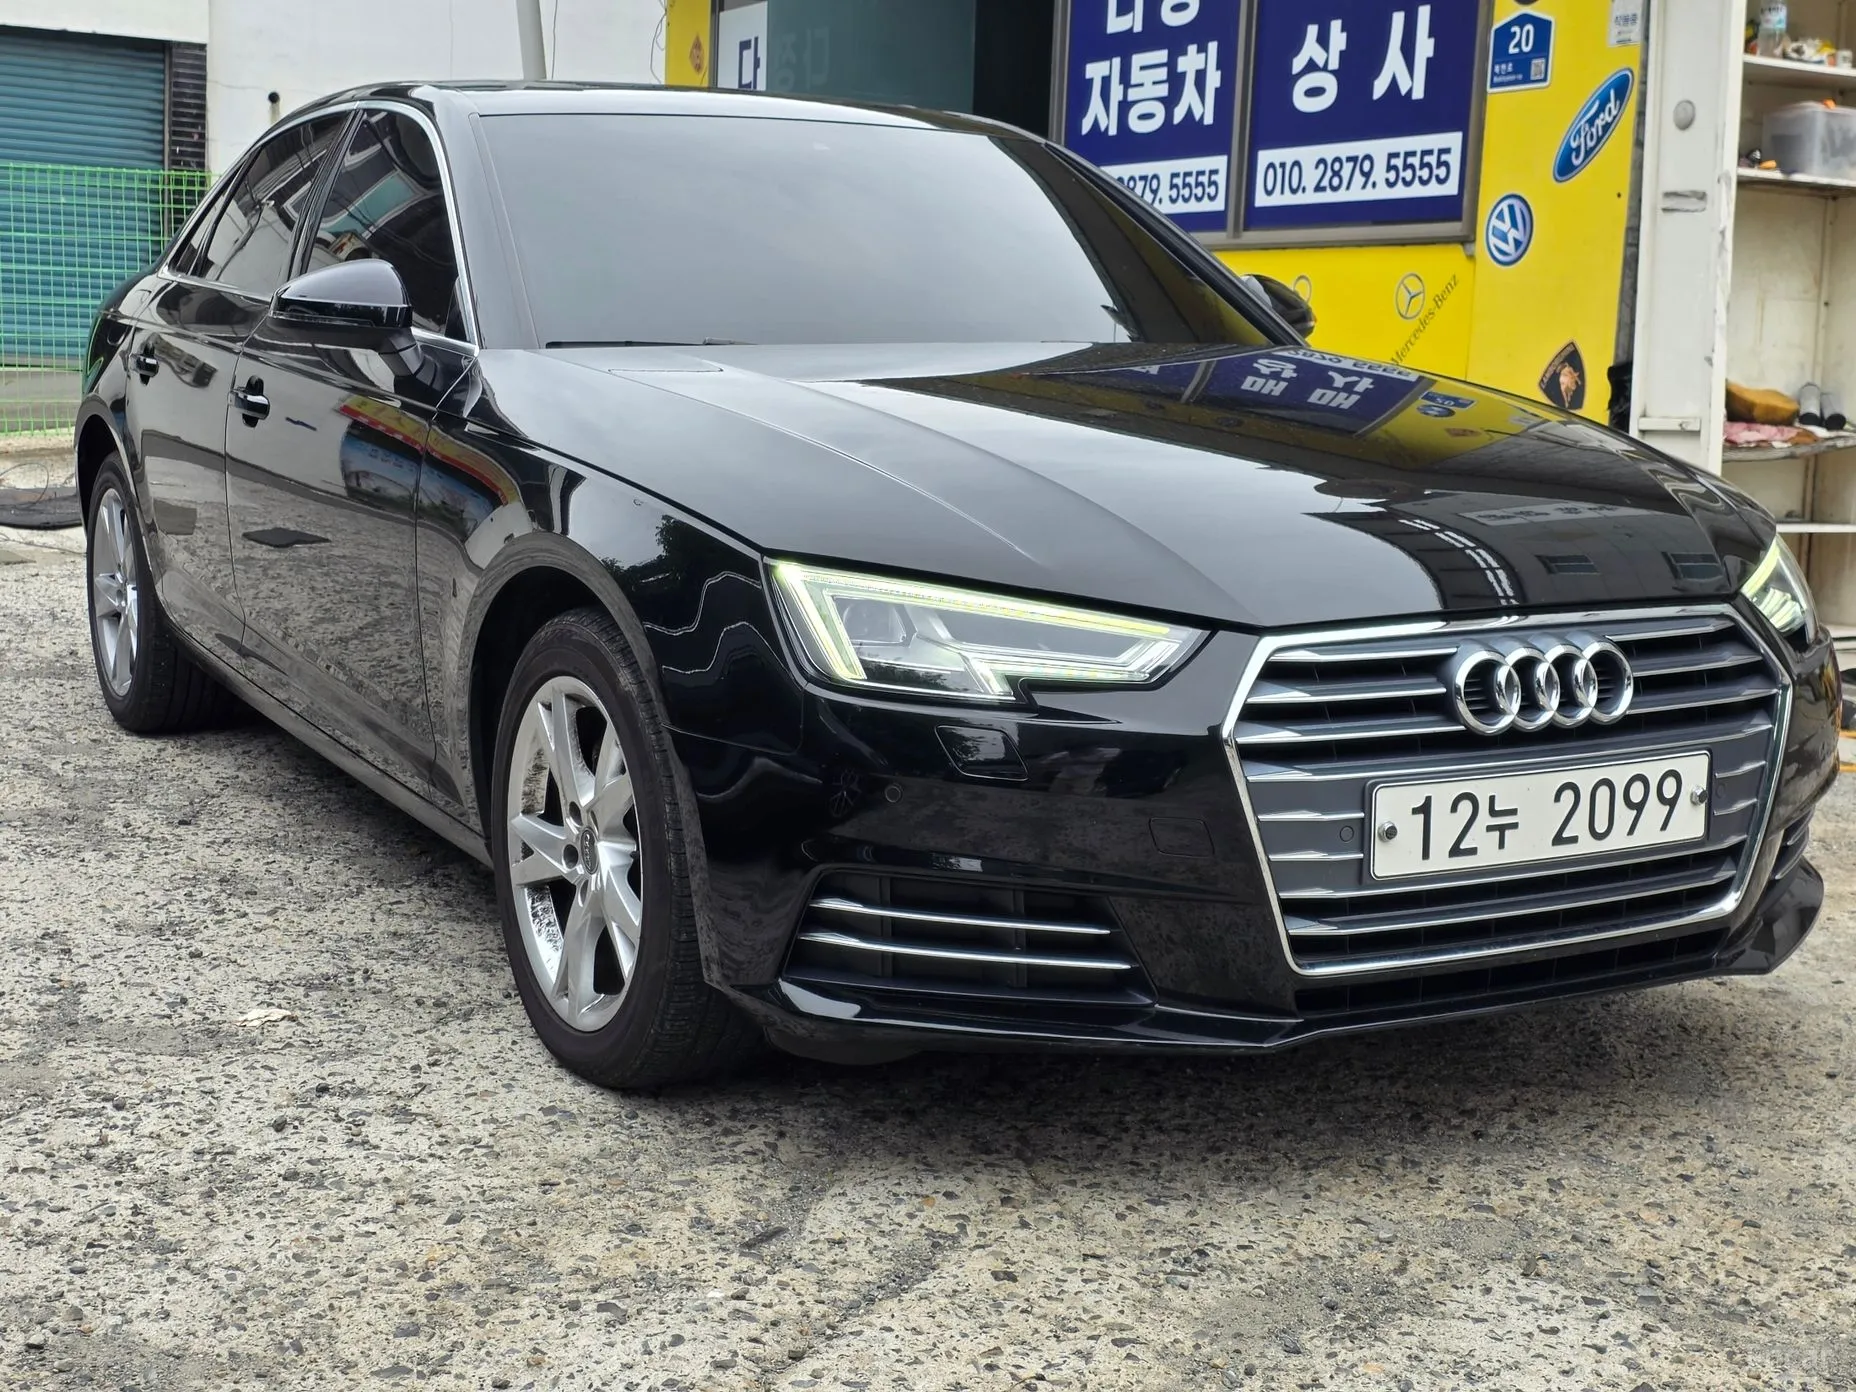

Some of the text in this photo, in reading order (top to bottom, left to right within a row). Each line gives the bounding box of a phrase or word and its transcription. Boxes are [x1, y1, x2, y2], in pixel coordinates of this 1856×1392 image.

[1508, 23, 1534, 54] 20
[1081, 40, 1221, 136] 자동차
[1570, 88, 1620, 166] Ford
[1411, 768, 1683, 861] 12누 2099
